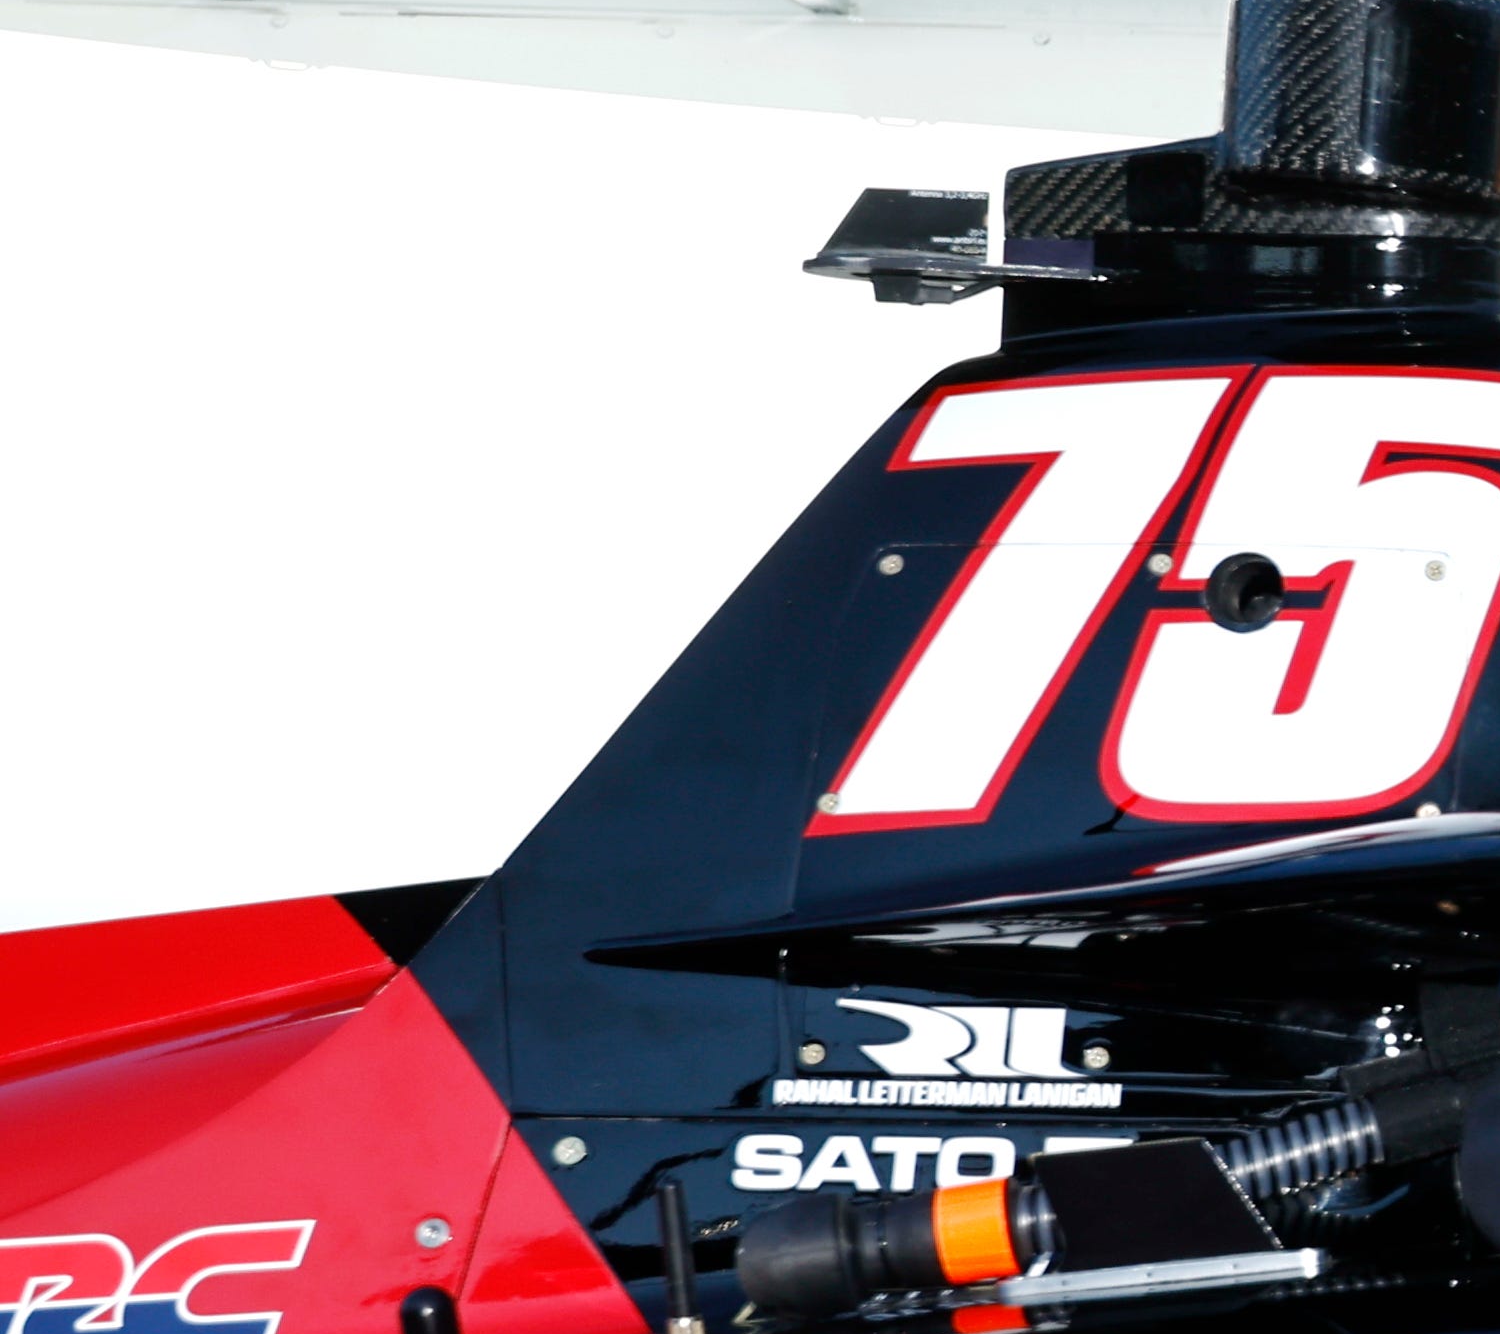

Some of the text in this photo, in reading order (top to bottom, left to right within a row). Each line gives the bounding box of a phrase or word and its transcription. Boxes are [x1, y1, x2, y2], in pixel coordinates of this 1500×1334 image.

[772, 1078, 1123, 1109] RAHAL LETTERMAN LANIGAN
[731, 1133, 1016, 1192] SATO
